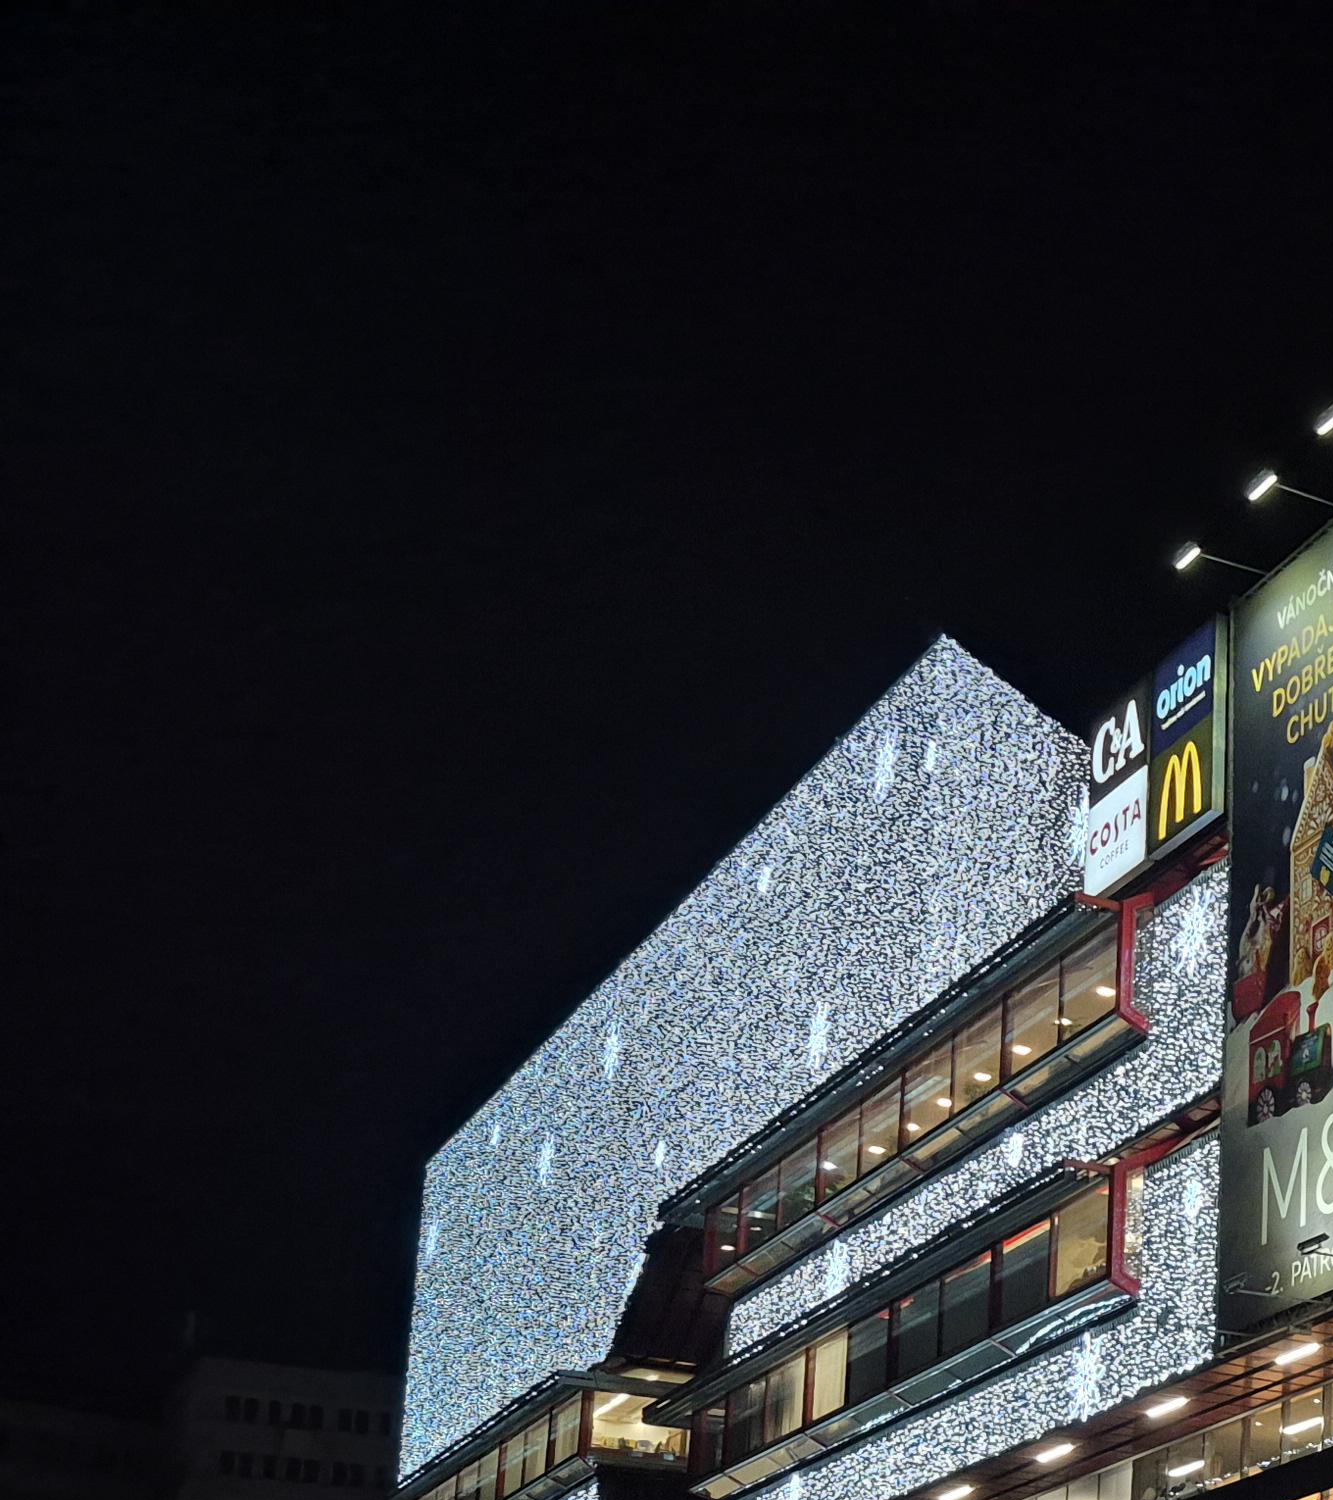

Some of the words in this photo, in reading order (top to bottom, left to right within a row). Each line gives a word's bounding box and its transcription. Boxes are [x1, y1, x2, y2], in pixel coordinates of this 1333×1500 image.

[1156, 654, 1211, 720] orion
[1092, 699, 1145, 784] C&A
[1089, 798, 1142, 857] COSTA
[1100, 839, 1129, 870] COFFEE
